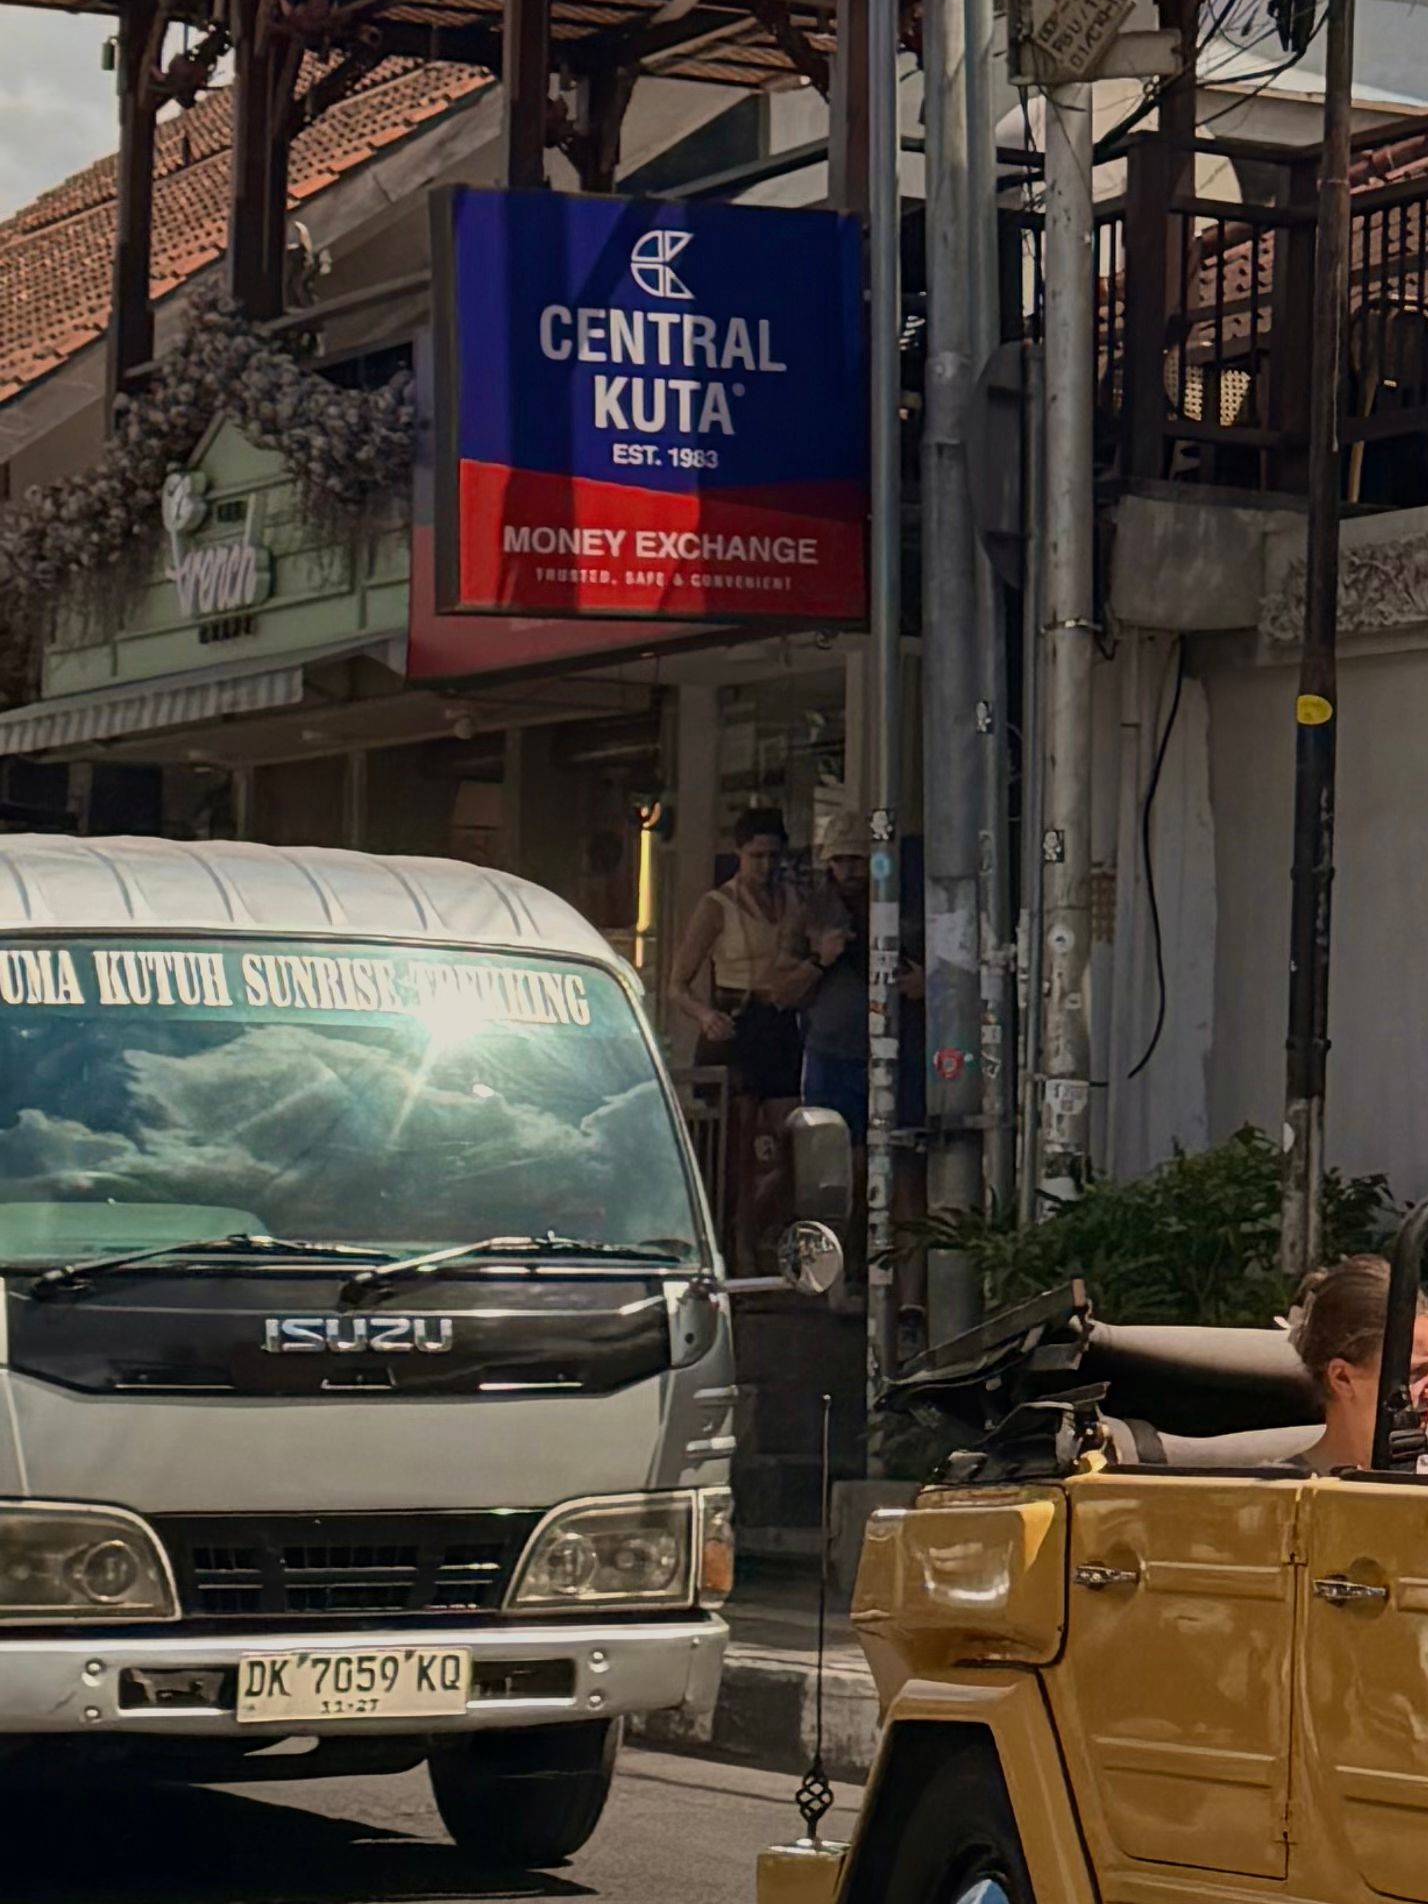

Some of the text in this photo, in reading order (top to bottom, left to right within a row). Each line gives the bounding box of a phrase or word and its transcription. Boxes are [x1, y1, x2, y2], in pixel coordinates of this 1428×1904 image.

[539, 303, 788, 373] CENTRAL
[594, 374, 736, 436] KUTA
[613, 442, 720, 470] EST. 1983
[502, 524, 820, 566] MONEY EXCHANGE
[690, 573, 793, 591] CONVENIENT
[93, 950, 234, 1007] KUTUH
[242, 954, 402, 1013] SUNRISE
[264, 1317, 454, 1353] ISUZU
[244, 1654, 461, 1698] DK 7059 KQ
